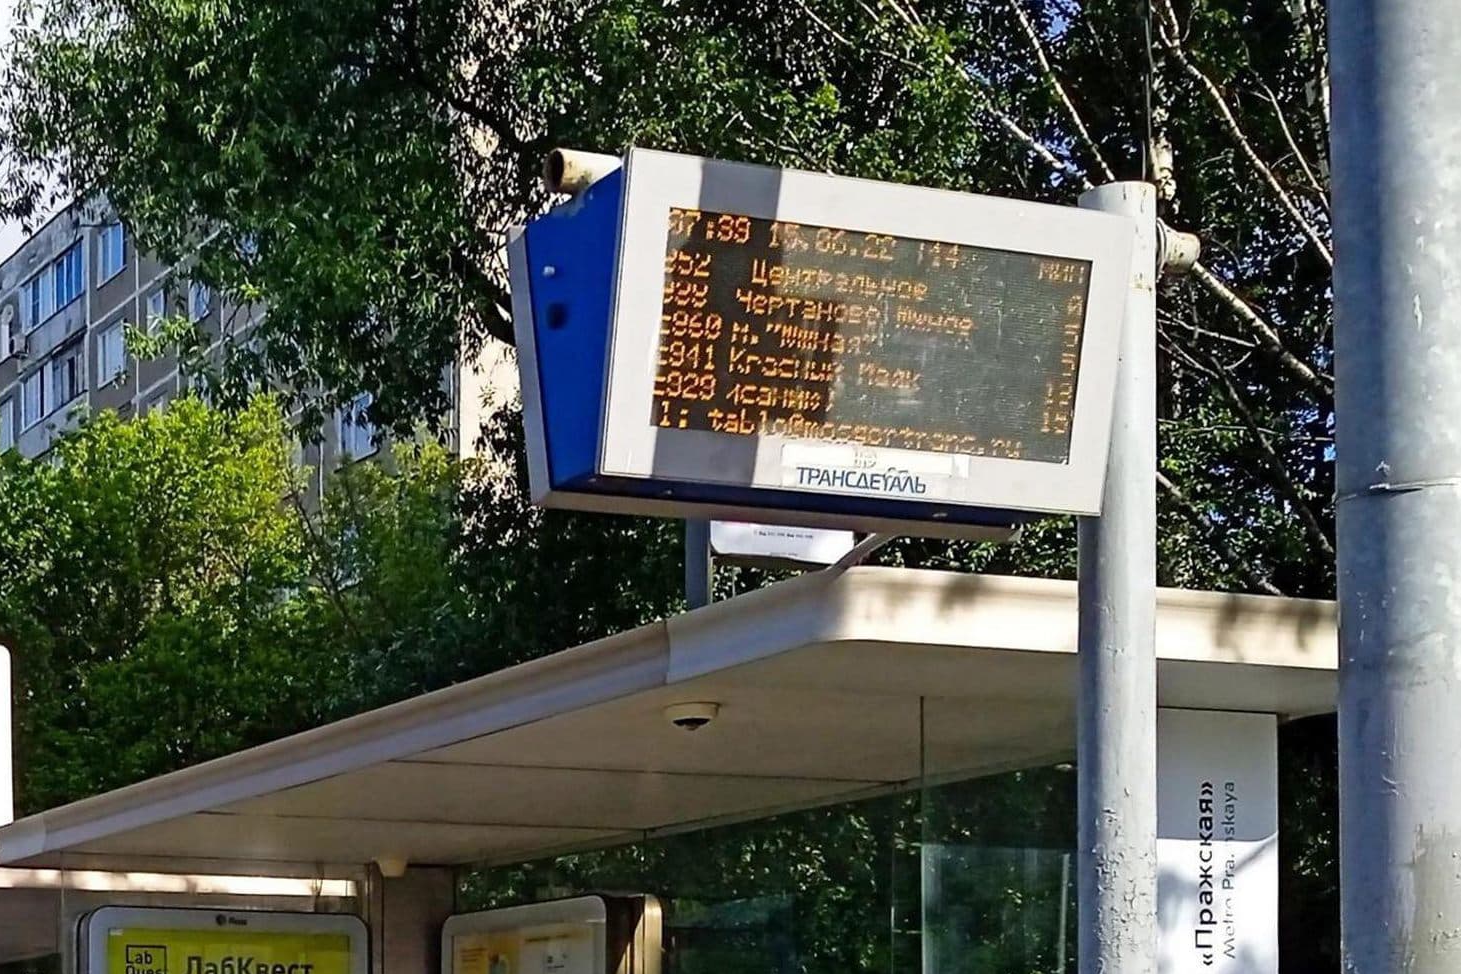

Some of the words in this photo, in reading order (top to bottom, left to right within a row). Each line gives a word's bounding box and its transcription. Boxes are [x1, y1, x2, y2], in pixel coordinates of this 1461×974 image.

[796, 466, 927, 494] ТРАНСДЕТАЛЬ
[1222, 781, 1238, 891] Praskaya
[1195, 781, 1218, 967] «Пражская»
[126, 949, 153, 964] Lab
